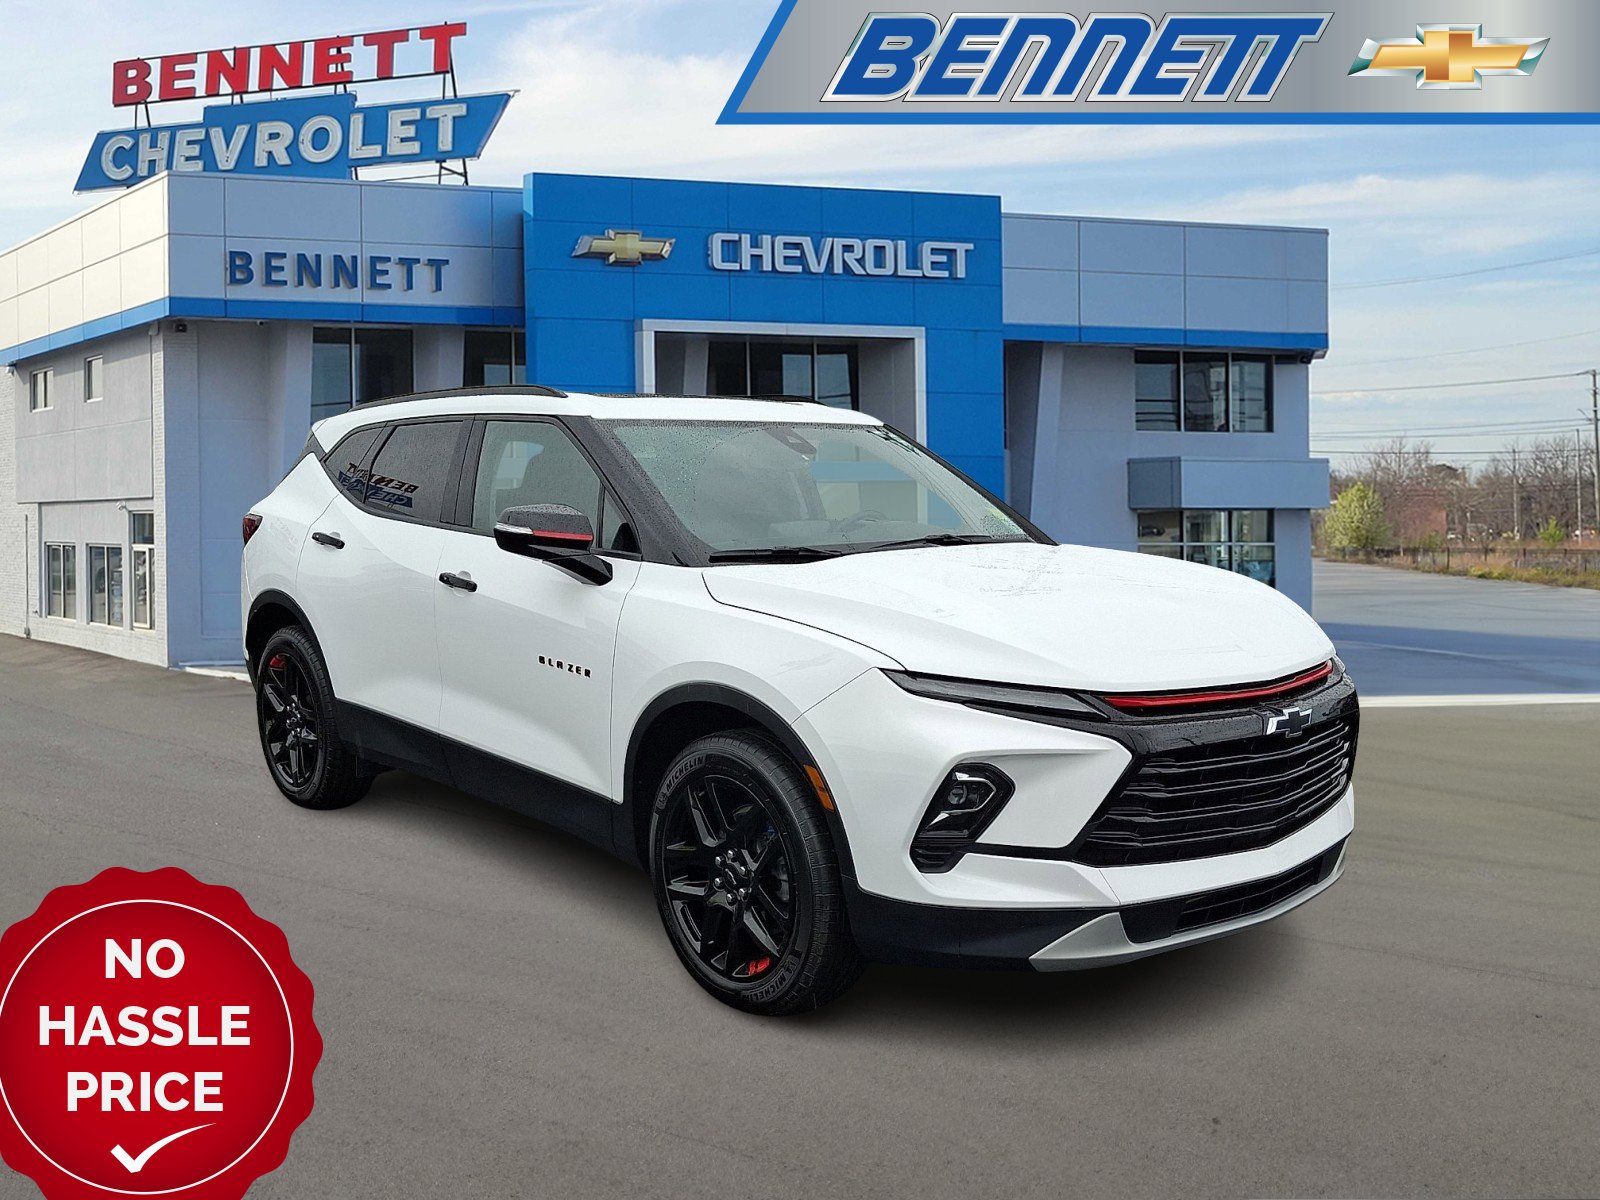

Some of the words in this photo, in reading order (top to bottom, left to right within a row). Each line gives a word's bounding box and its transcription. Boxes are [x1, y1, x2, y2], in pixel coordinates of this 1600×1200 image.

[112, 22, 467, 107] BENNETT
[100, 104, 468, 181] CHEVROLET
[226, 250, 450, 293] BENNETT
[707, 232, 975, 279] CHEVROLET
[538, 655, 591, 678] BLAZER
